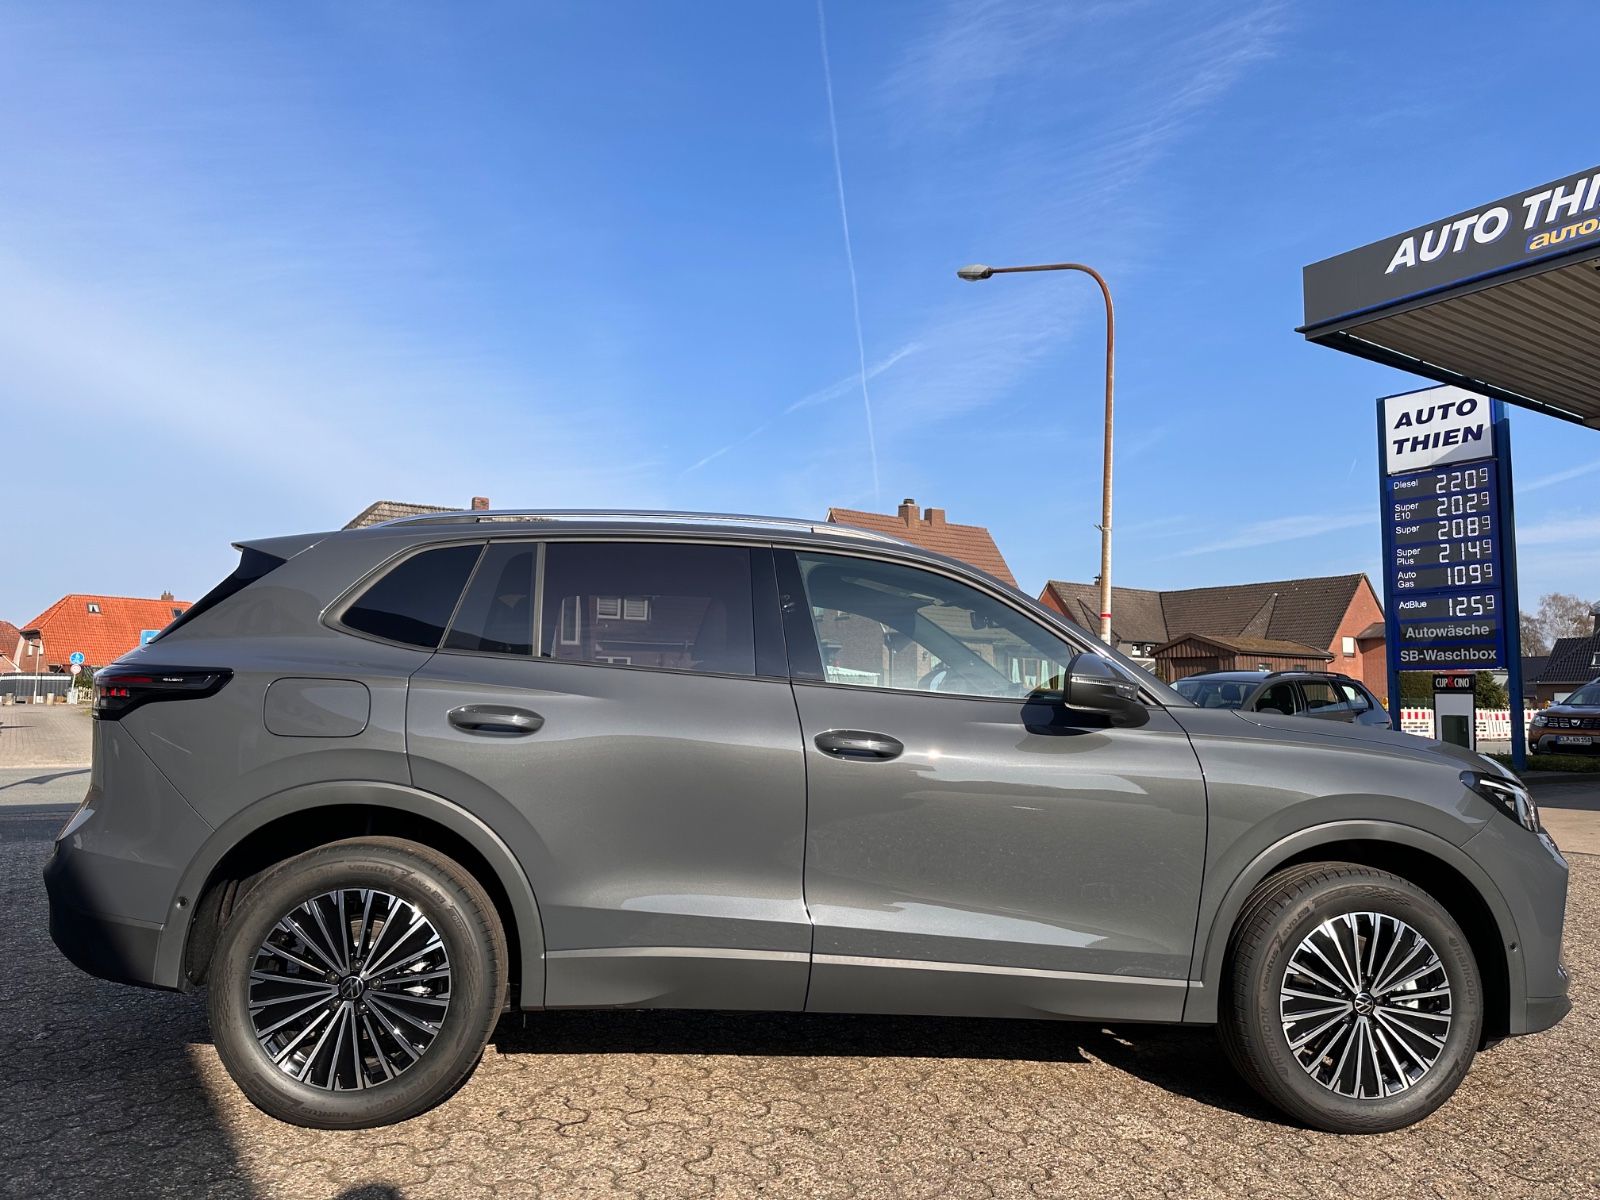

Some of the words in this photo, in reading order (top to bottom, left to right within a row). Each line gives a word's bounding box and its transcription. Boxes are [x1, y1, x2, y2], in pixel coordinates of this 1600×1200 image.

[1384, 206, 1510, 274] AUTO
[1522, 173, 1600, 230] THI
[1529, 218, 1600, 250] auto
[1393, 398, 1478, 429] AUTO
[1392, 423, 1484, 455] THIEN
[1393, 479, 1419, 490] Diesel
[1394, 503, 1419, 512] Super
[1395, 512, 1411, 521] E10
[1395, 525, 1420, 535] Super
[1396, 547, 1421, 557] Super
[1396, 558, 1415, 566] Plus
[1397, 571, 1417, 580] Auto
[1398, 580, 1415, 589] Gas
[1398, 600, 1428, 610] AdBlue
[1405, 624, 1490, 639] Autowäsche
[1400, 648, 1497, 662] SB-Waschbox
